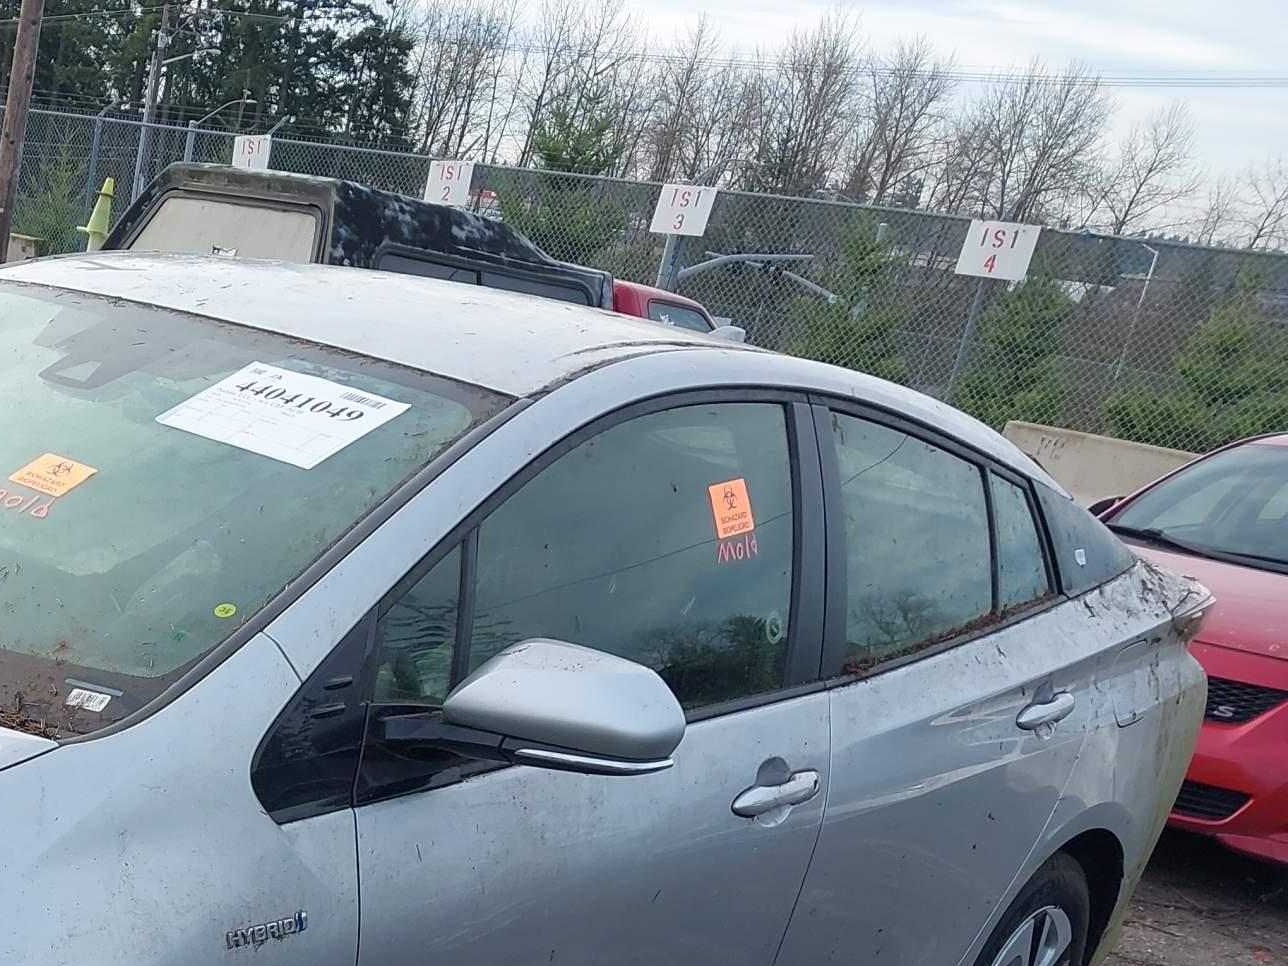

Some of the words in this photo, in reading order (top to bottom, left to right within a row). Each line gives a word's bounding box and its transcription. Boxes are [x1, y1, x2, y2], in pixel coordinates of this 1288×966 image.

[441, 185, 451, 201] 2
[673, 213, 685, 230] 3
[983, 253, 997, 273] 4
[235, 380, 365, 421] 44041049
[225, 917, 297, 950] HYBRID
